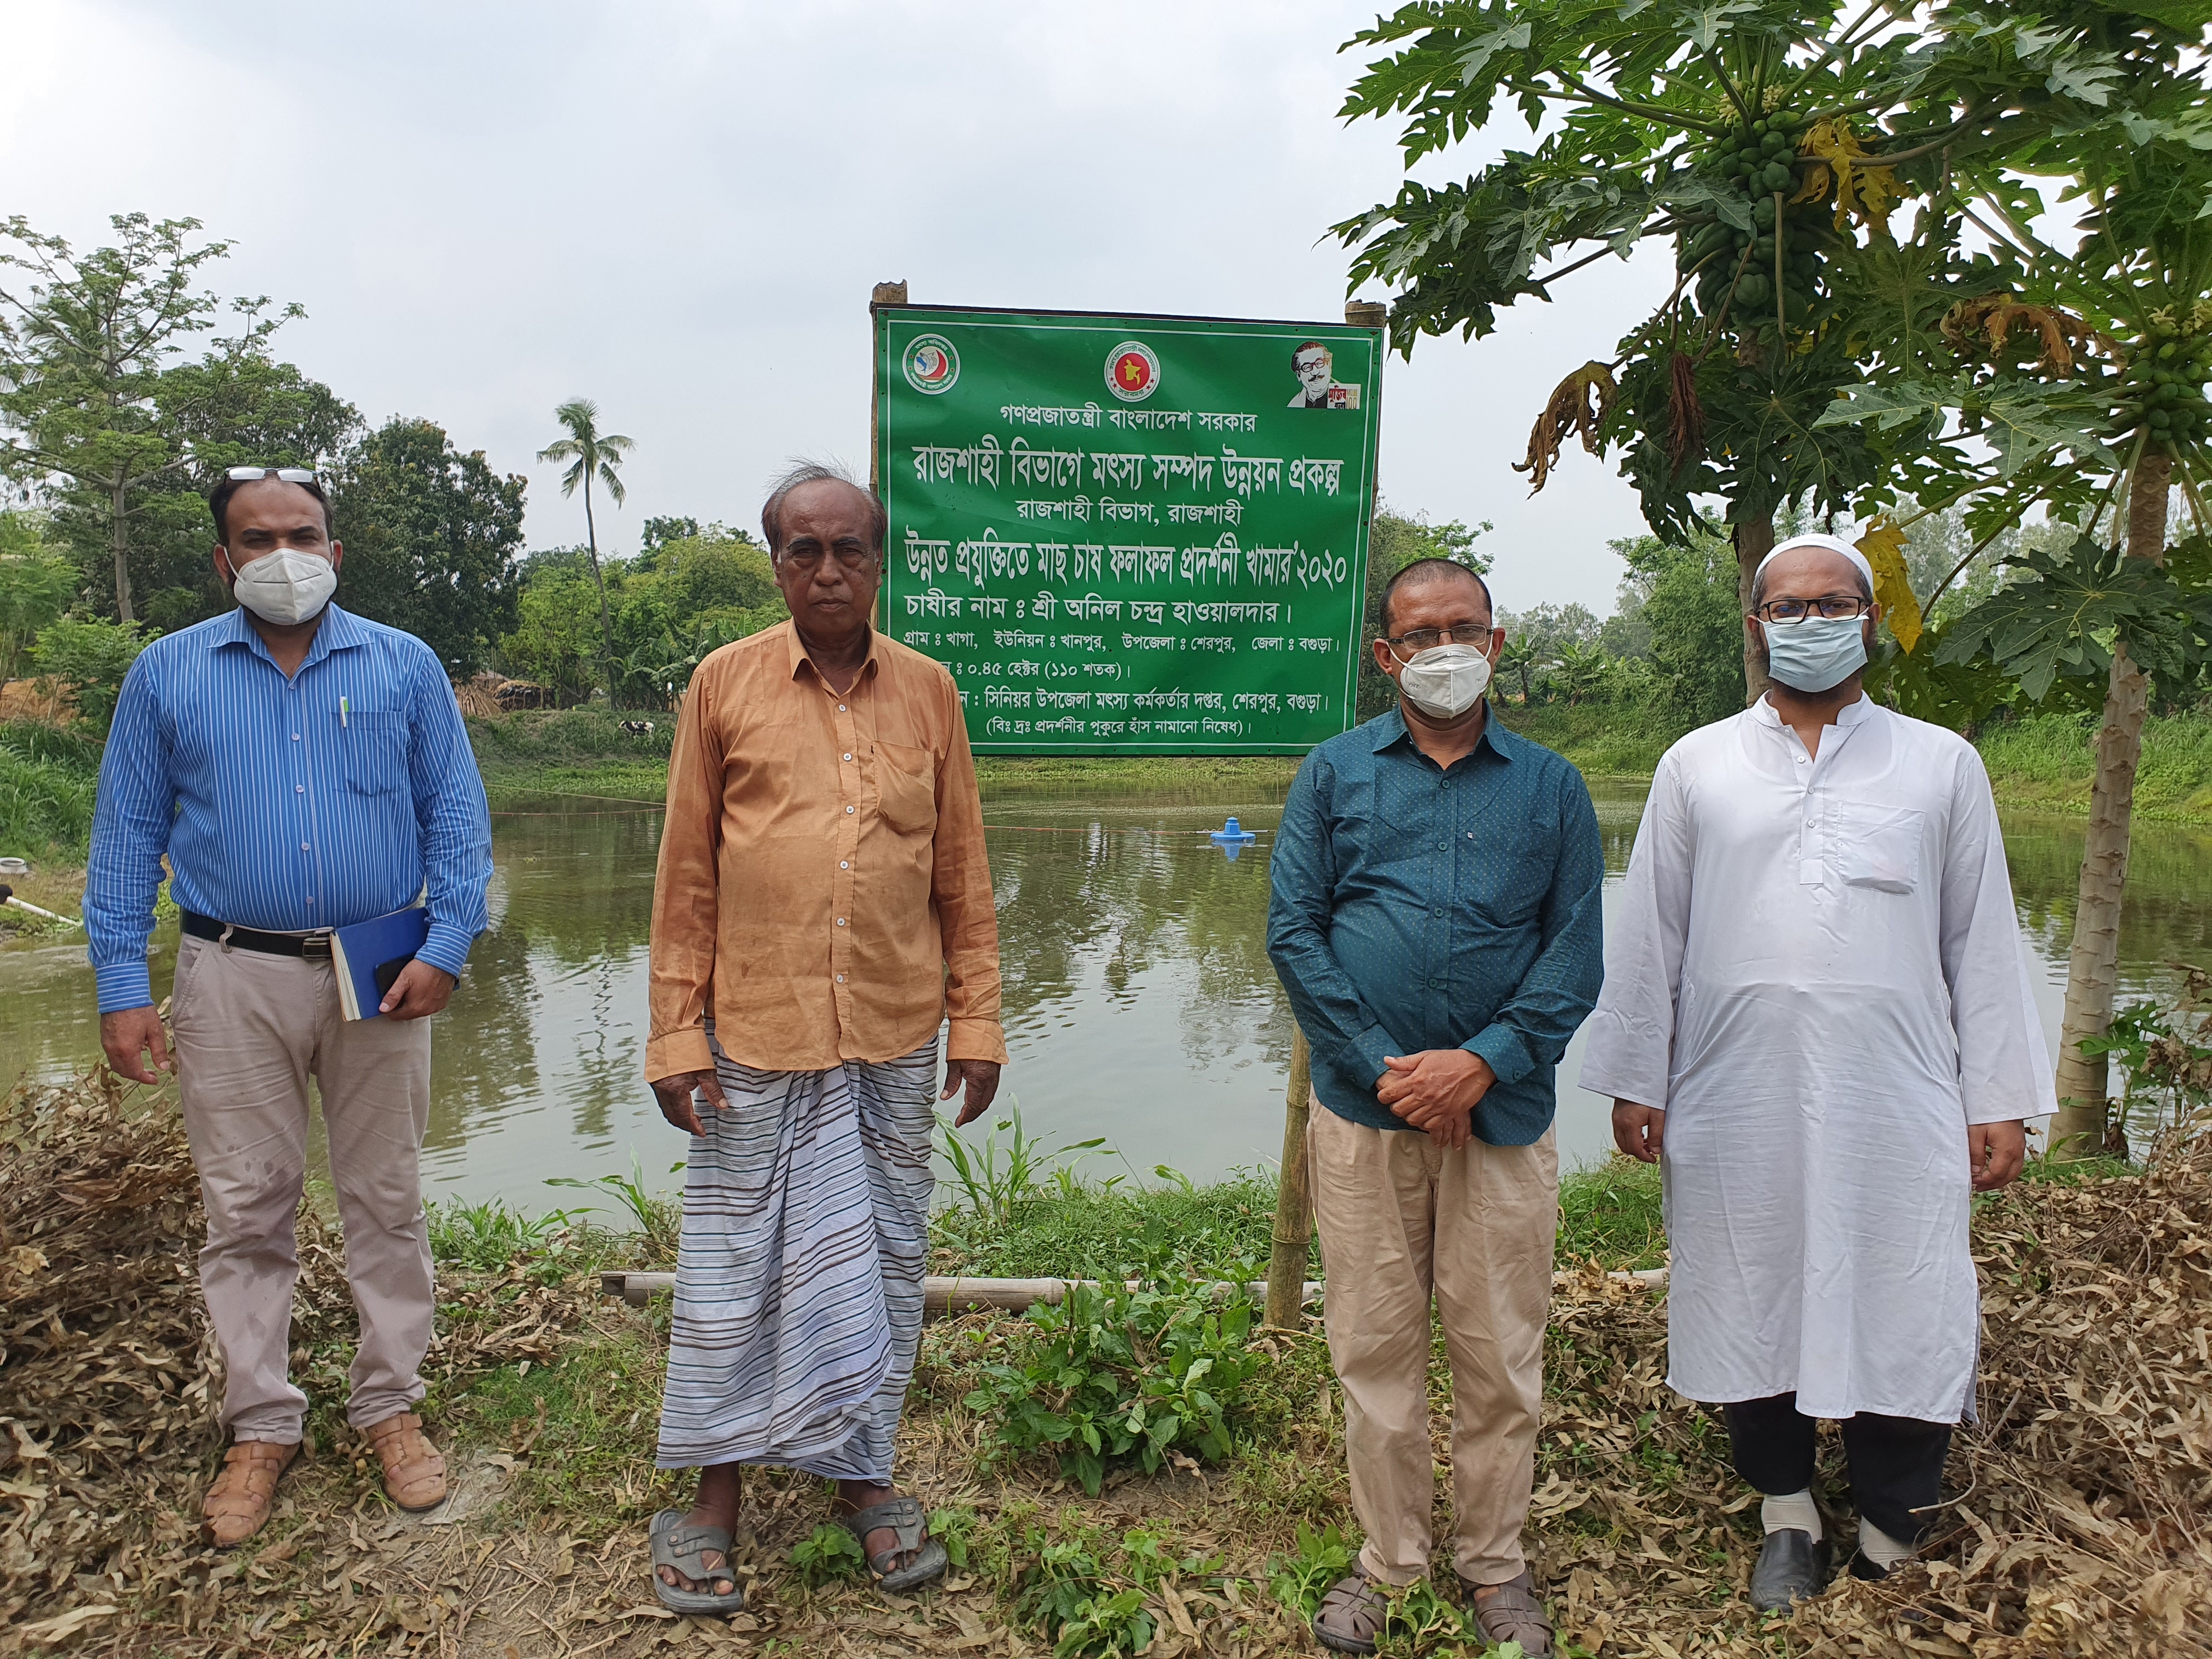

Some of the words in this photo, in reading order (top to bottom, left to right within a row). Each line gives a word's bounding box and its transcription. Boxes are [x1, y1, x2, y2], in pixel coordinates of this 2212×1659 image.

[1000, 401, 1104, 429] গণপ্রজাতন্ত্রী
[1107, 408, 1193, 431] বাংলাদেশ
[1197, 411, 1258, 433] সরকার
[911, 433, 1005, 492] রাজশাহী
[1008, 436, 1086, 489] বিভাগে
[1089, 453, 1147, 491] মৎস্য
[1150, 451, 1216, 492] সম্পদ
[1220, 443, 1285, 501] উন্নয়ন
[1288, 454, 1345, 497] প্রকল্প
[1014, 494, 1094, 524] রাজশাহী
[1097, 496, 1160, 527] বিভাগ,
[1166, 498, 1245, 527] রাজশাহী
[903, 524, 951, 587] উন্নত
[955, 527, 1032, 591] প্রযুক্তিতে
[1035, 538, 1070, 586] মাছ
[1073, 539, 1105, 583] চাষ
[1108, 540, 1177, 585] ফলাফল
[1180, 531, 1242, 587] প্রদর্শনী
[903, 587, 964, 618] চাষীর
[968, 595, 1009, 619] নাম
[1031, 590, 1059, 621] শ্রী
[1063, 592, 1125, 622] অনিল
[1128, 600, 1167, 626] চন্দ্র
[903, 630, 931, 646] গ্রাম
[946, 631, 979, 650] খাগা,
[993, 629, 1046, 649] ইউনিয়ন
[1060, 633, 1107, 653] খানপুর,
[1121, 631, 1177, 651] উপজেলা
[1190, 635, 1236, 654] শেরপুর,
[1251, 636, 1285, 651] জেলা
[967, 662, 1003, 676] ০.৪৫
[1007, 658, 1041, 678] হেক্টর
[1045, 661, 1078, 680] (১১০
[984, 685, 1033, 709] সিনিয়র
[1035, 686, 1093, 710] উপজেলা
[1094, 692, 1130, 710] মৎস্য
[1132, 686, 1191, 710] কর্মকর্তার
[1193, 691, 1227, 714] দপ্তর,
[1232, 691, 1281, 715] শেরপুর,
[1035, 716, 1086, 734] প্রদর্শনীর
[1090, 720, 1126, 738] পুকুরে
[1128, 716, 1152, 735] হাঁস
[1154, 719, 1199, 734] নামানো
